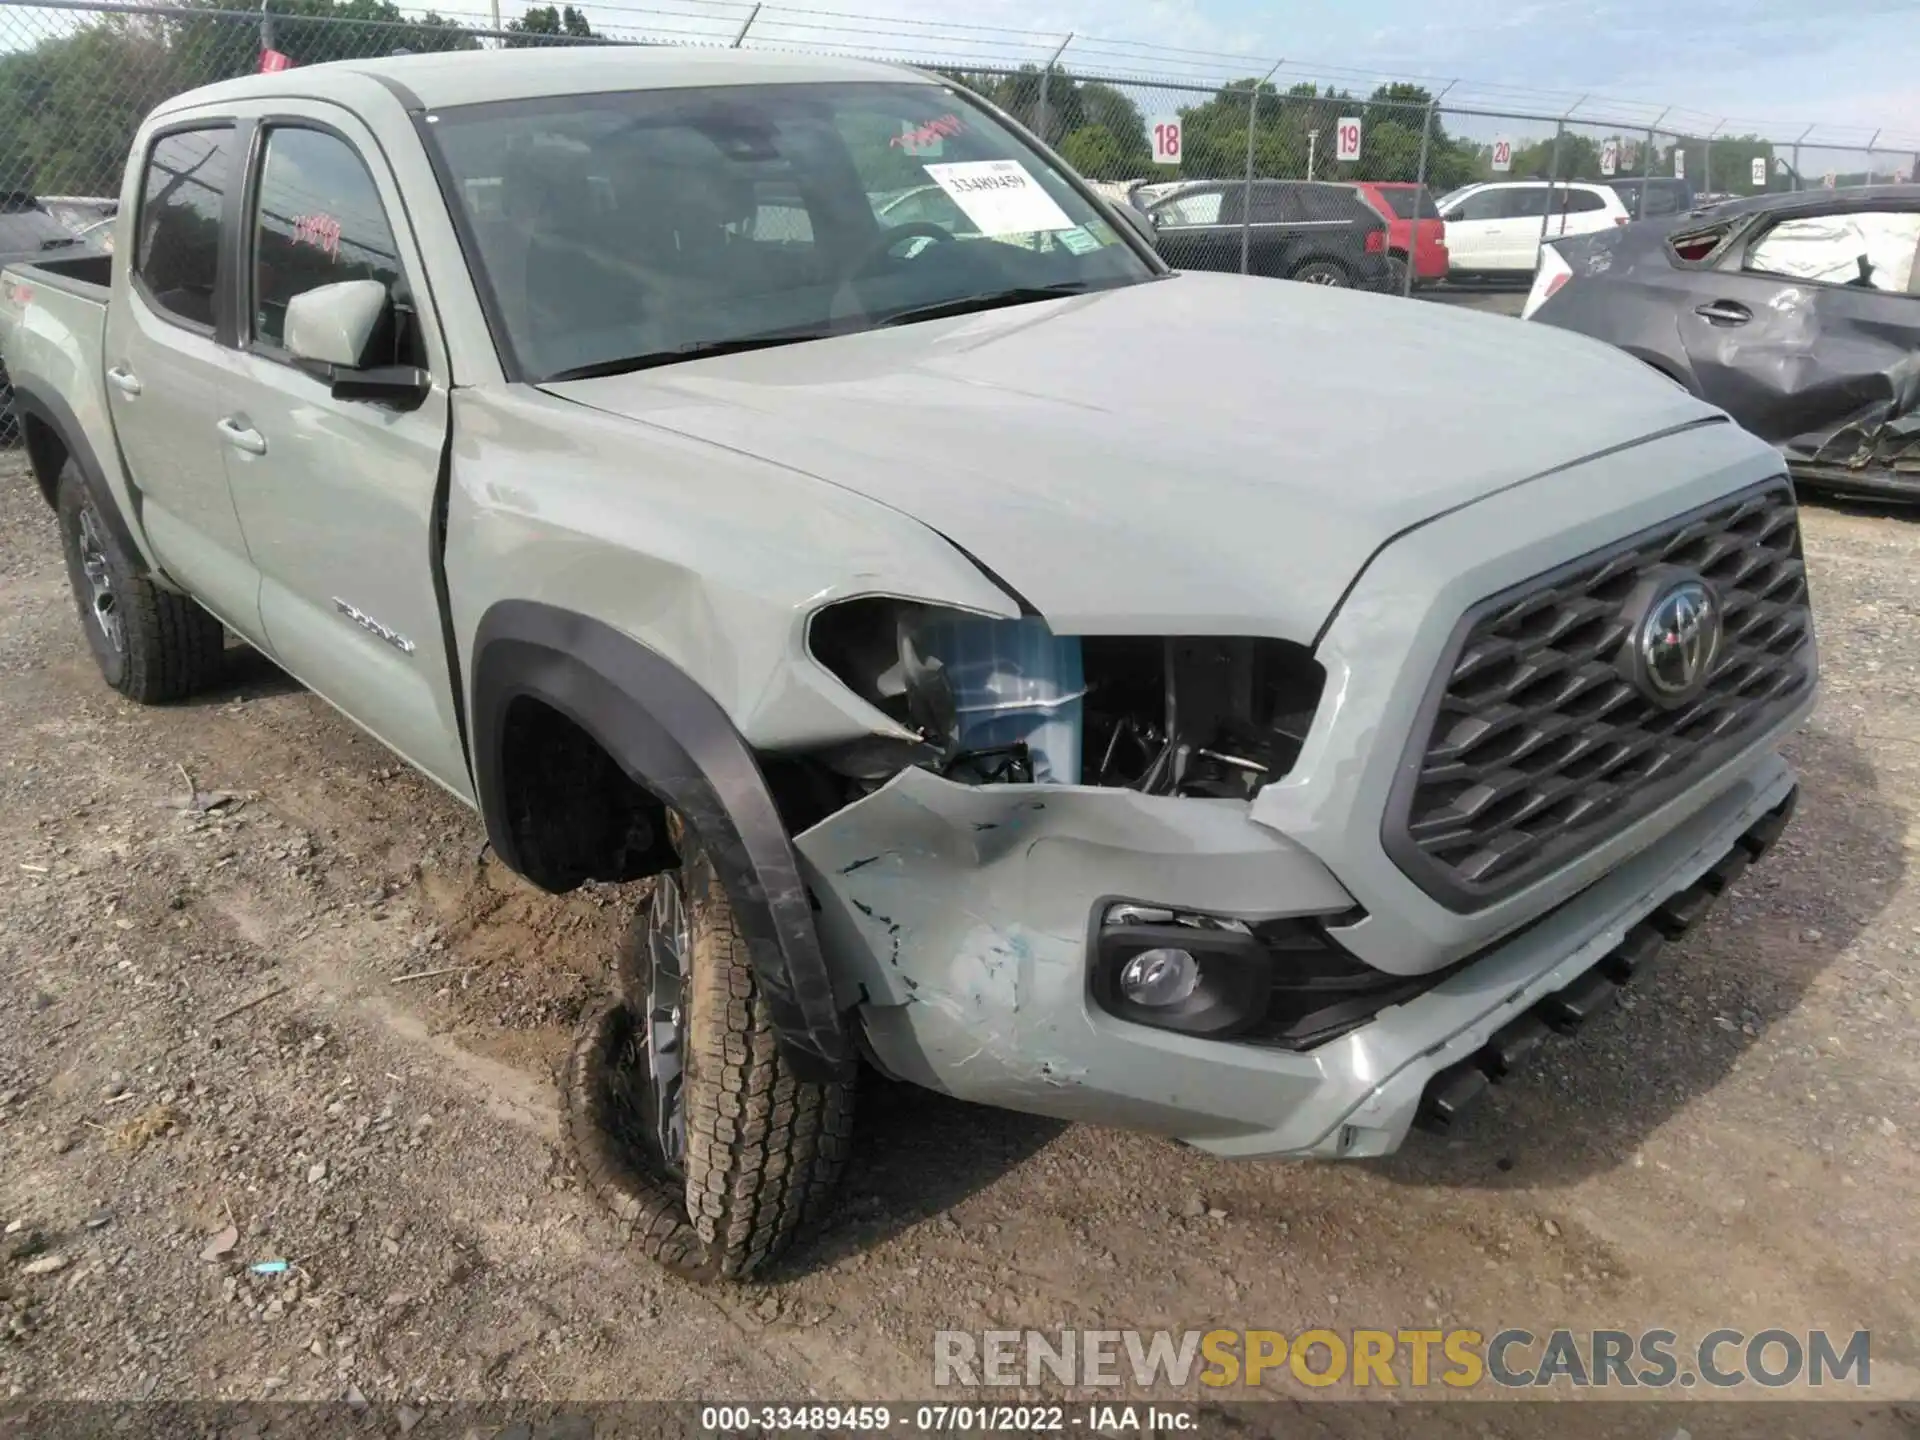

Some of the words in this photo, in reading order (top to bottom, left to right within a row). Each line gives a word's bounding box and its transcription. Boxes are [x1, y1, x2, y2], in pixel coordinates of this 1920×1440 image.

[1154, 123, 1179, 156] 18
[1340, 125, 1359, 153] 19
[1494, 141, 1510, 164] 20
[1603, 146, 1616, 169] 21
[948, 174, 1027, 194] 33489459
